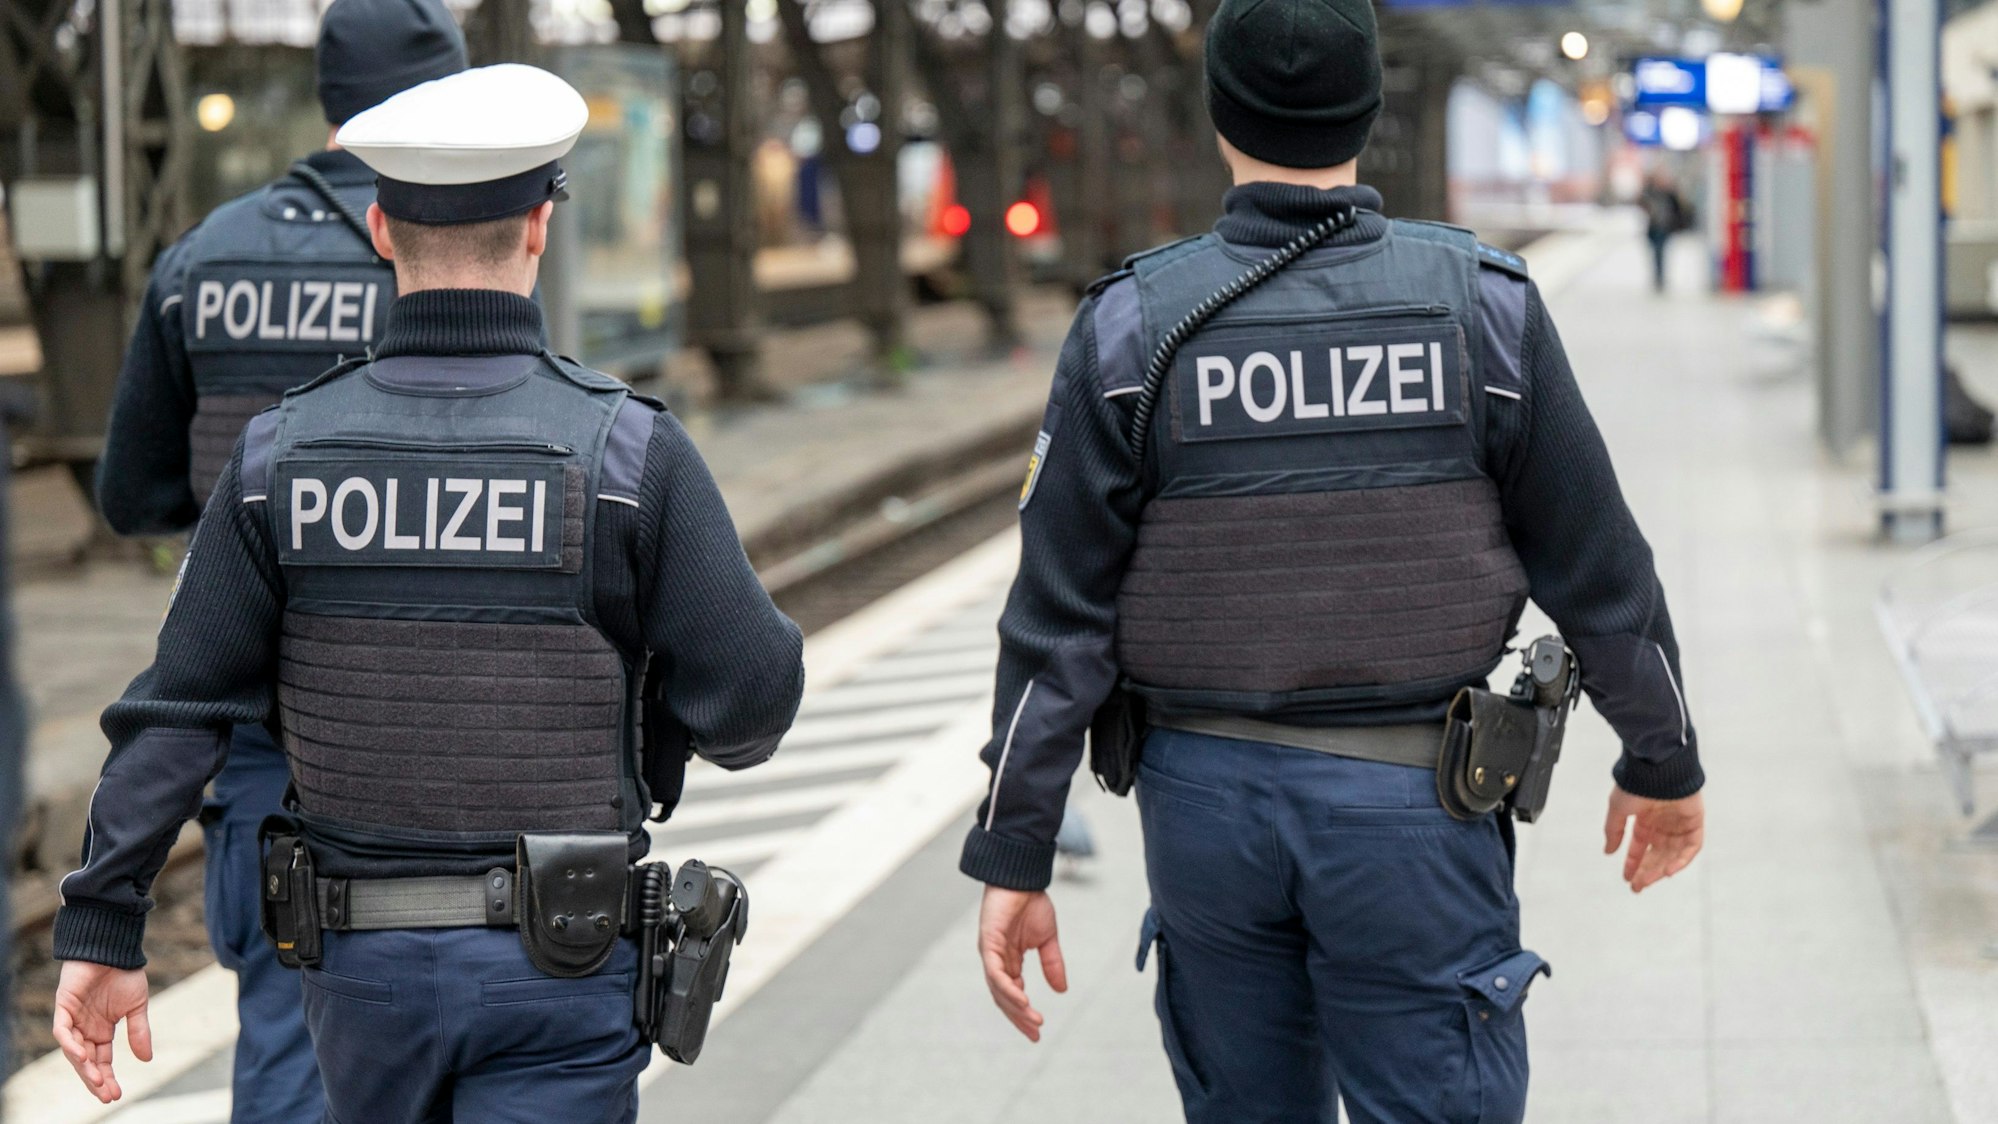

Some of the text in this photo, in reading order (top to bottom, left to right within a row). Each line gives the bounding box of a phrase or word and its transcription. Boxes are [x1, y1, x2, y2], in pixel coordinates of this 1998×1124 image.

[196, 280, 379, 341] POLIZEI
[1196, 342, 1445, 425] POLIZEI
[291, 477, 547, 552] POLIZEI
